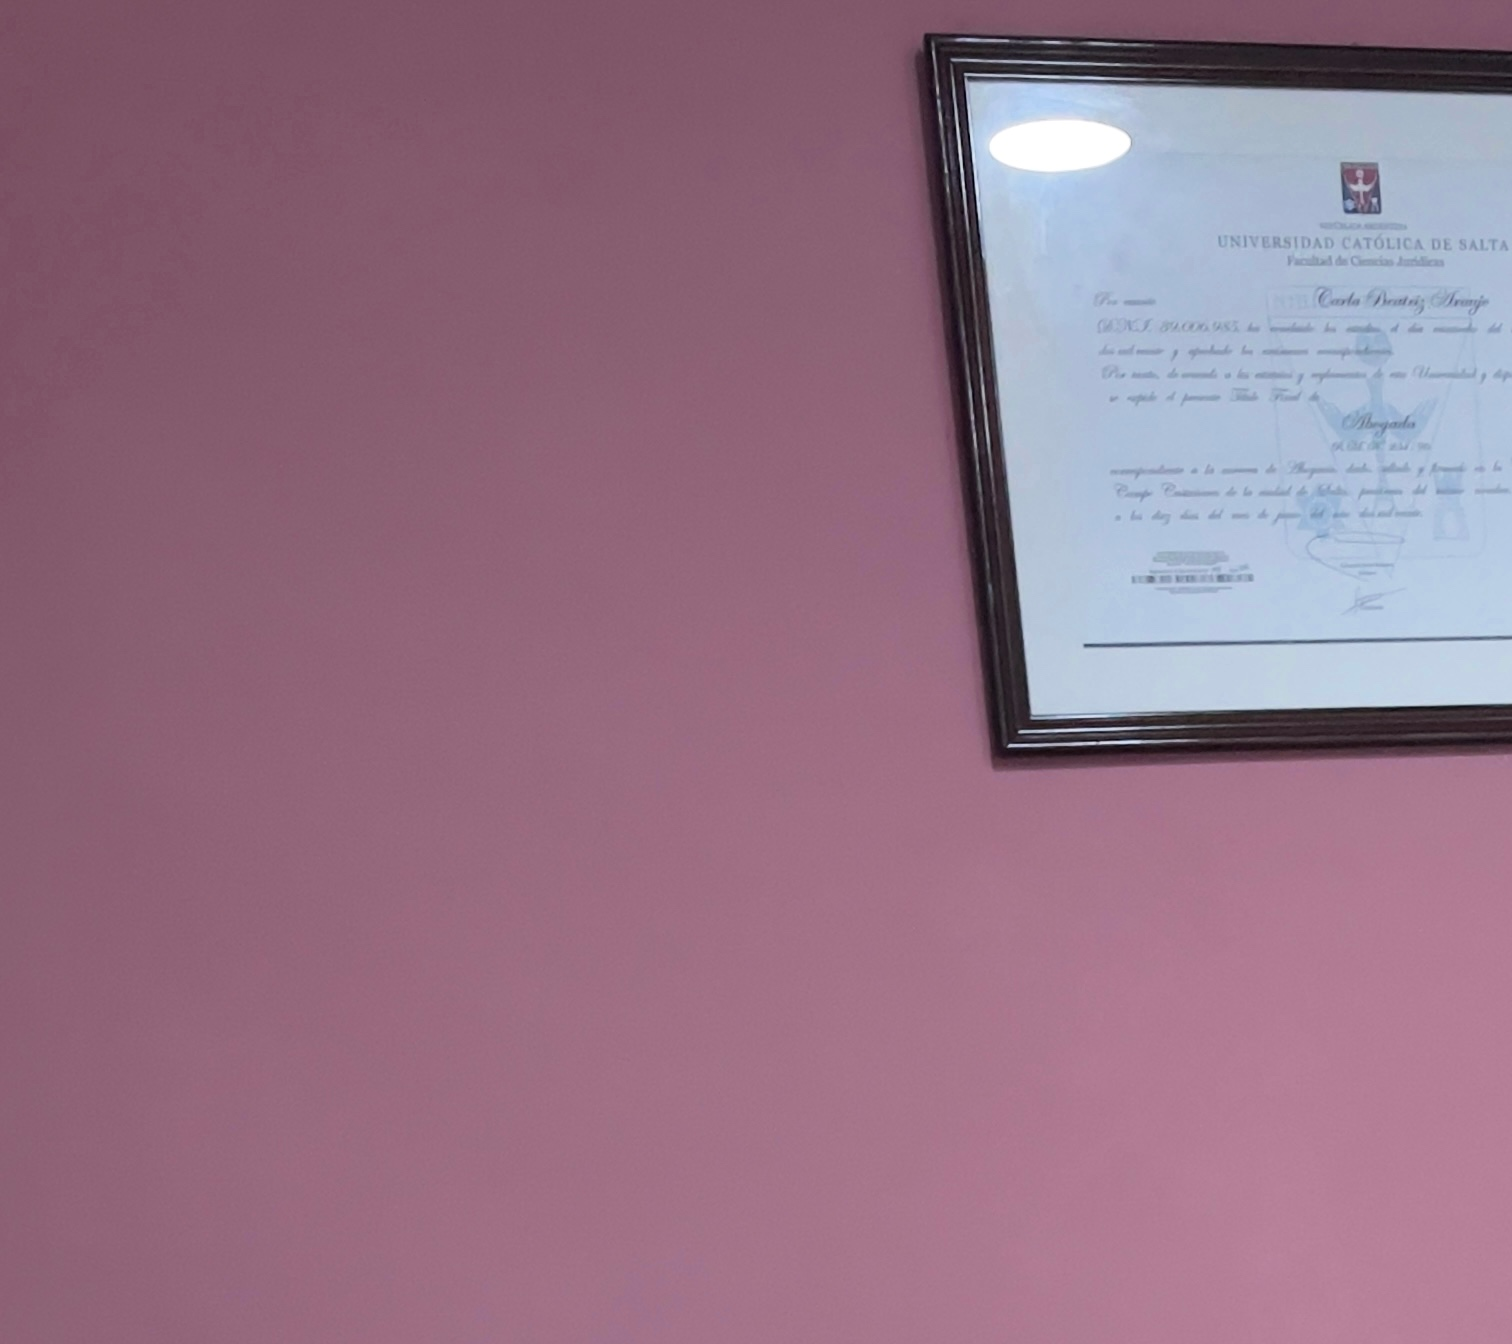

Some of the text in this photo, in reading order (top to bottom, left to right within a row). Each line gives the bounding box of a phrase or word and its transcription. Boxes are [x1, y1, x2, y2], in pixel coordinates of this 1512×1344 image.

[1217, 233, 1510, 252] UNIVERSIDAD CATÓLICA DE SALTA
[1286, 255, 1333, 267] Facultad
[1335, 256, 1348, 267] de
[1313, 286, 1361, 308] Carla
[1368, 288, 1426, 315] Beatriz
[1341, 413, 1416, 437] Abogada
